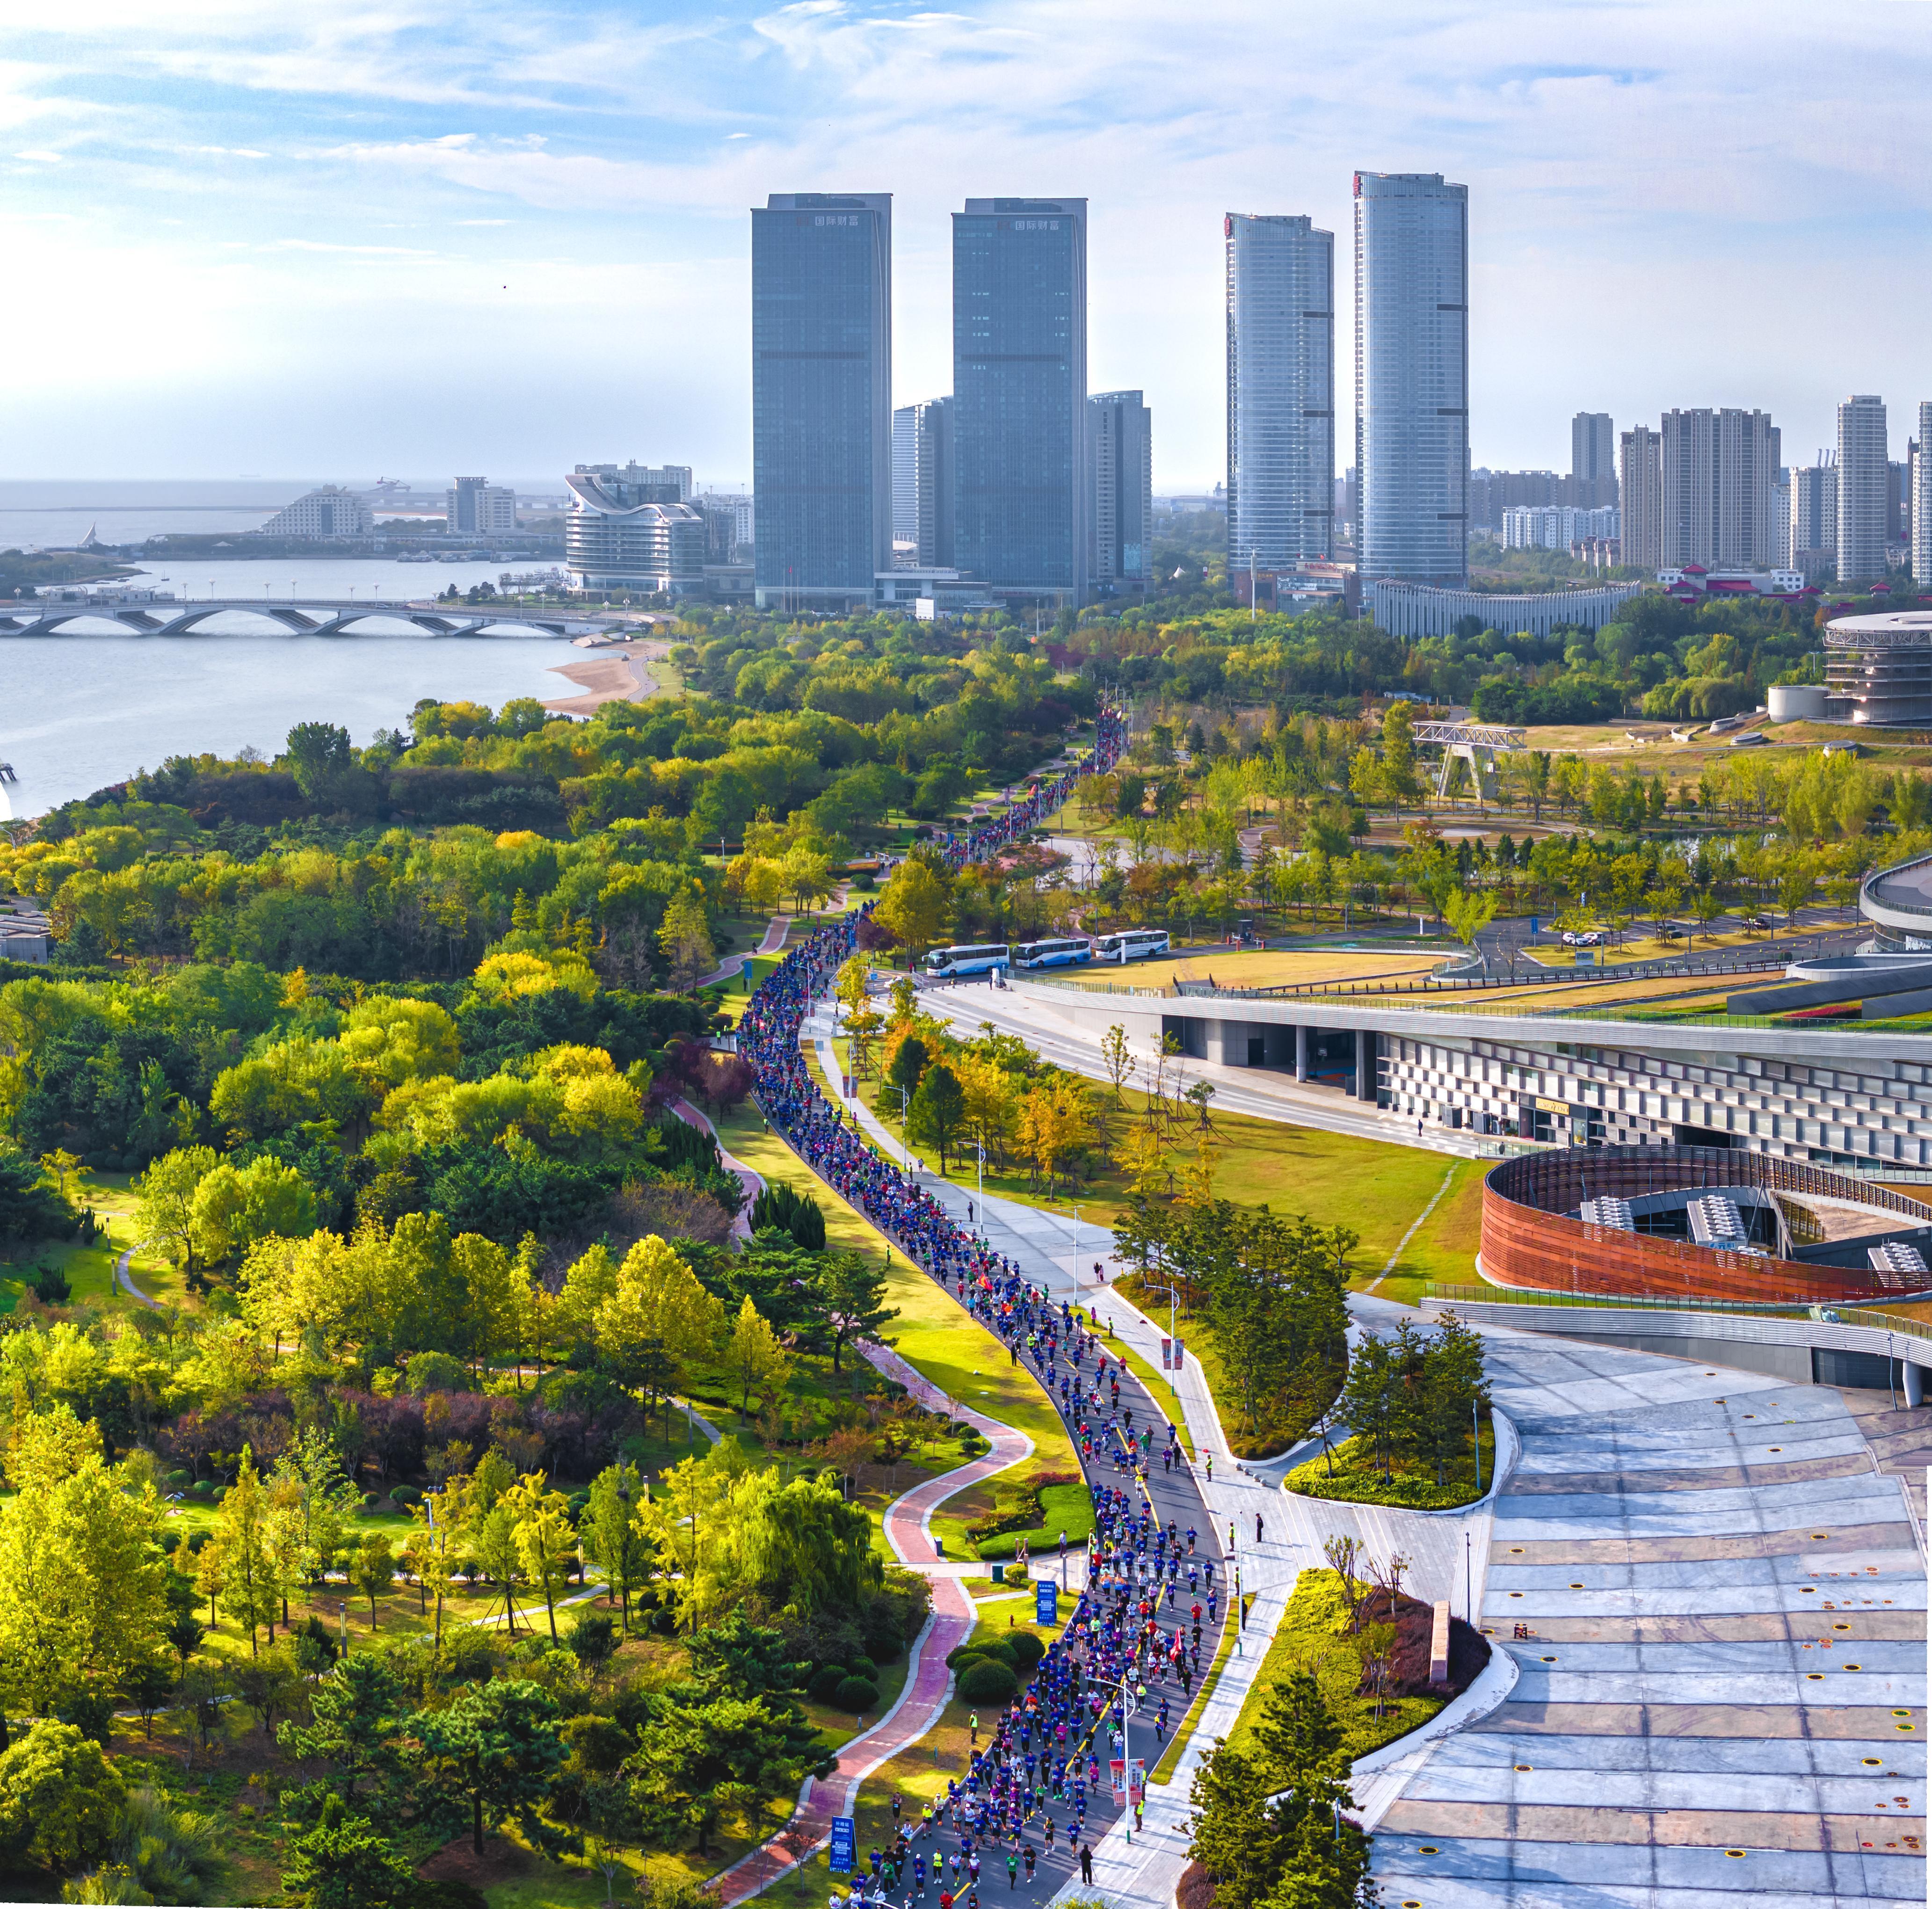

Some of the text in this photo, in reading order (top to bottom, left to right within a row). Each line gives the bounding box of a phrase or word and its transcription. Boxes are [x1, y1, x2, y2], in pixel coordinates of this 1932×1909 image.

[815, 216, 858, 226] 国际财富
[1015, 220, 1059, 231] 国际财富
